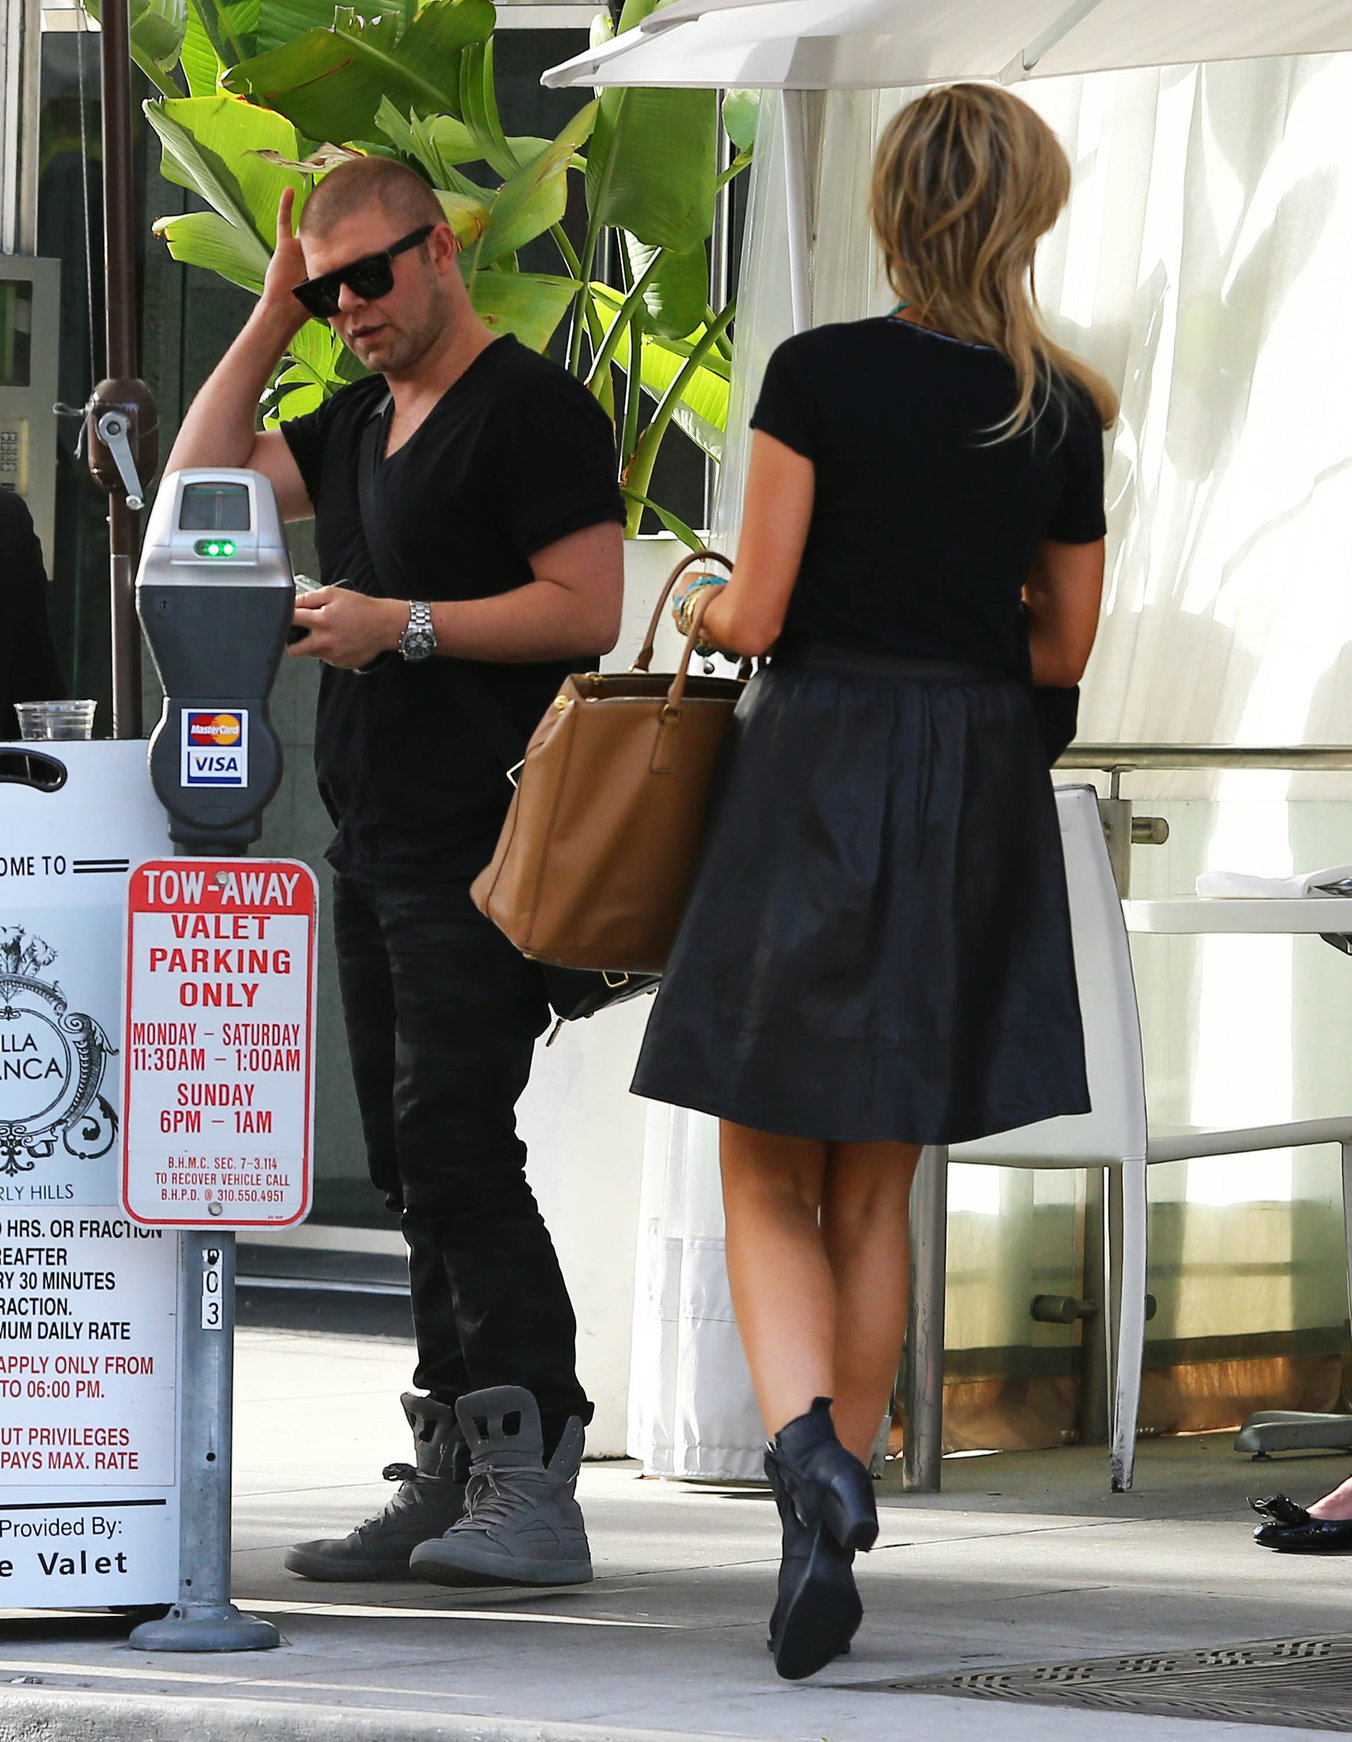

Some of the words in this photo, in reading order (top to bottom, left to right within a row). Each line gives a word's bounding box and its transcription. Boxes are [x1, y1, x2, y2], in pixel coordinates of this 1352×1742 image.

[190, 724, 240, 736] MasterCard
[193, 756, 238, 771] VISA
[42, 855, 66, 875] TO
[143, 869, 299, 906] TOW-AWAY
[172, 915, 271, 940] VALET
[150, 948, 291, 974] PARKING
[179, 982, 259, 1007] ONLY
[133, 1024, 197, 1046] MONDAY
[222, 1024, 301, 1046] SATURDAY
[0, 1057, 64, 1080] NCA
[133, 1049, 206, 1071] 11:30AM
[236, 1049, 301, 1072] 1:00AM
[177, 1084, 255, 1107] SUNDAY
[160, 1110, 201, 1134] 6PM
[234, 1110, 273, 1134] 1AM
[168, 1157, 209, 1169] B.H.M.C.
[214, 1158, 236, 1170] SEC.
[241, 1158, 277, 1170] 7-3.114
[155, 1172, 167, 1184] TO
[171, 1173, 217, 1185] RECOVER
[221, 1174, 262, 1186] VEHICLE
[266, 1174, 290, 1186] CALL
[31, 1184, 73, 1199] HILLS
[161, 1189, 199, 1201] B.H.P.D.
[217, 1190, 284, 1202] 310.550.4951
[7, 1220, 45, 1238] HRS.
[50, 1220, 74, 1238] OR
[0, 1248, 67, 1265] EAFTER
[19, 1272, 37, 1289] 30
[42, 1272, 115, 1290] MINUTES
[38, 1322, 83, 1339] DAILY
[88, 1322, 130, 1340] RATE
[0, 1356, 49, 1374] APPLY
[55, 1356, 99, 1374] ONLY
[105, 1357, 153, 1374] FROM
[0, 1380, 22, 1398] TO
[27, 1381, 70, 1398] 06:00
[76, 1381, 105, 1398] PM.
[1, 1428, 23, 1445] UT
[29, 1428, 129, 1446] PRIVILEGES
[1, 1452, 42, 1469] PAYS
[48, 1452, 90, 1469] MAX.
[95, 1452, 138, 1469] RATE
[0, 1517, 84, 1537] Provided
[92, 1517, 122, 1539] By:
[38, 1550, 127, 1576] Valet
